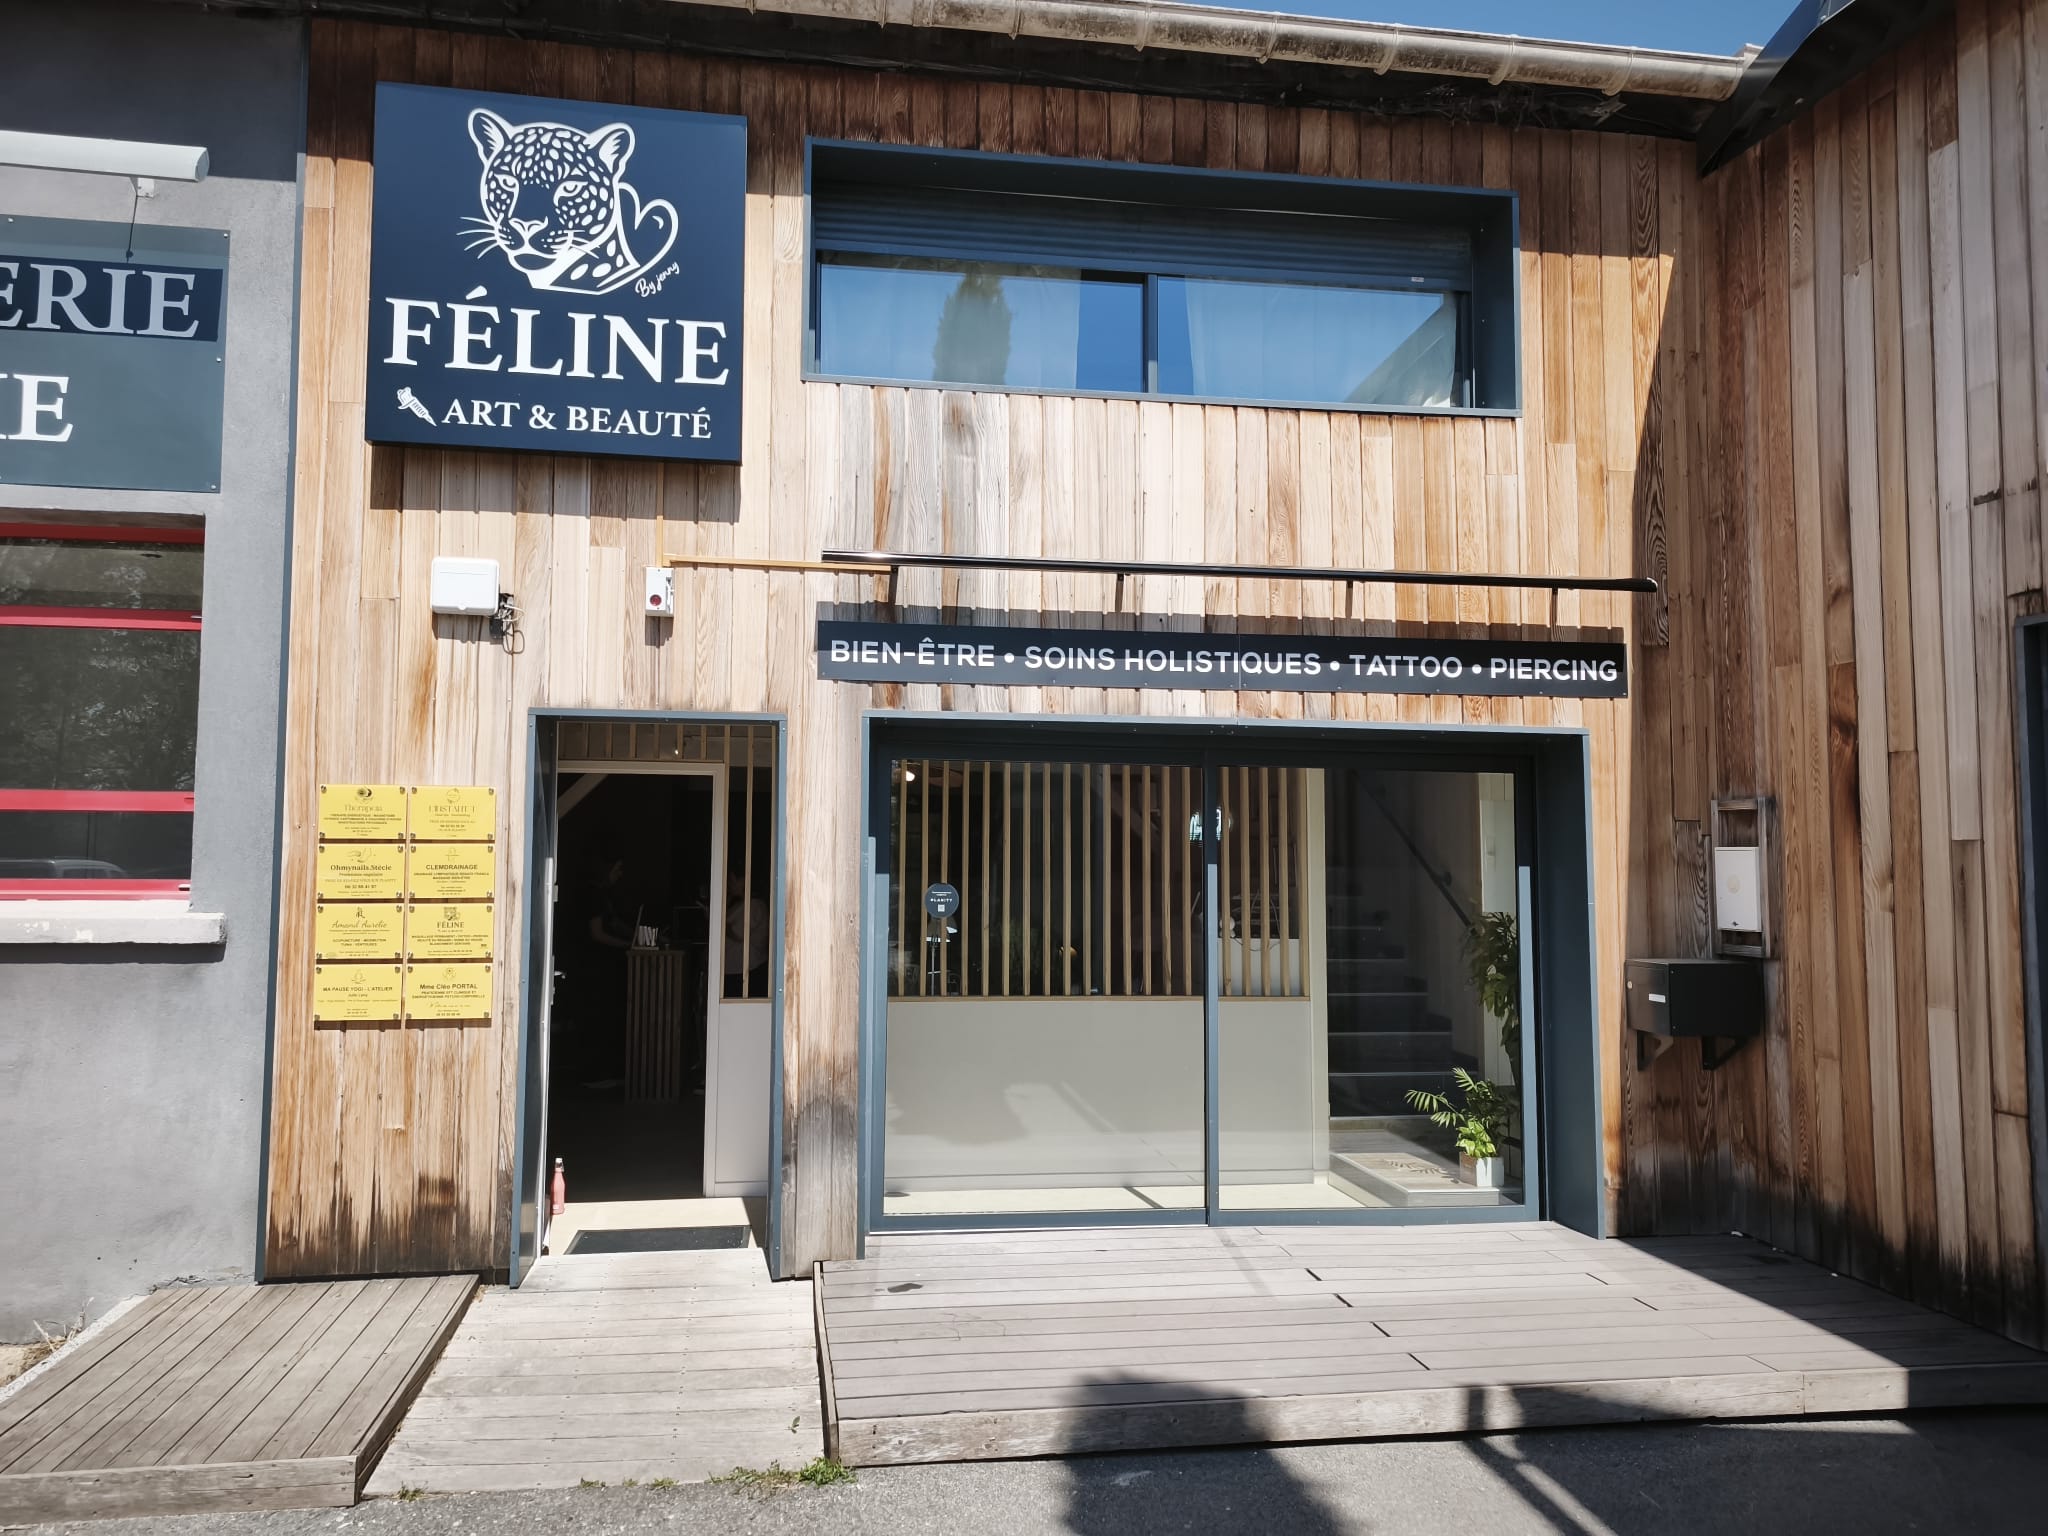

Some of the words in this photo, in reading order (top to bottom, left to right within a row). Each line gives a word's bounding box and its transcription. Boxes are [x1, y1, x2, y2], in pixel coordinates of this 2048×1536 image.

[635, 277, 656, 298] By
[383, 285, 730, 386] FÉLINE
[441, 398, 521, 429] ART
[528, 404, 558, 431] &
[566, 405, 712, 440] BEAUTÉ
[831, 637, 995, 667] BIEN-ÊTRE
[1024, 646, 1116, 671] SOINS
[1124, 649, 1321, 676] HOLISTIQUES
[1349, 654, 1463, 679] TATTOO
[1490, 658, 1618, 683] PIERCING
